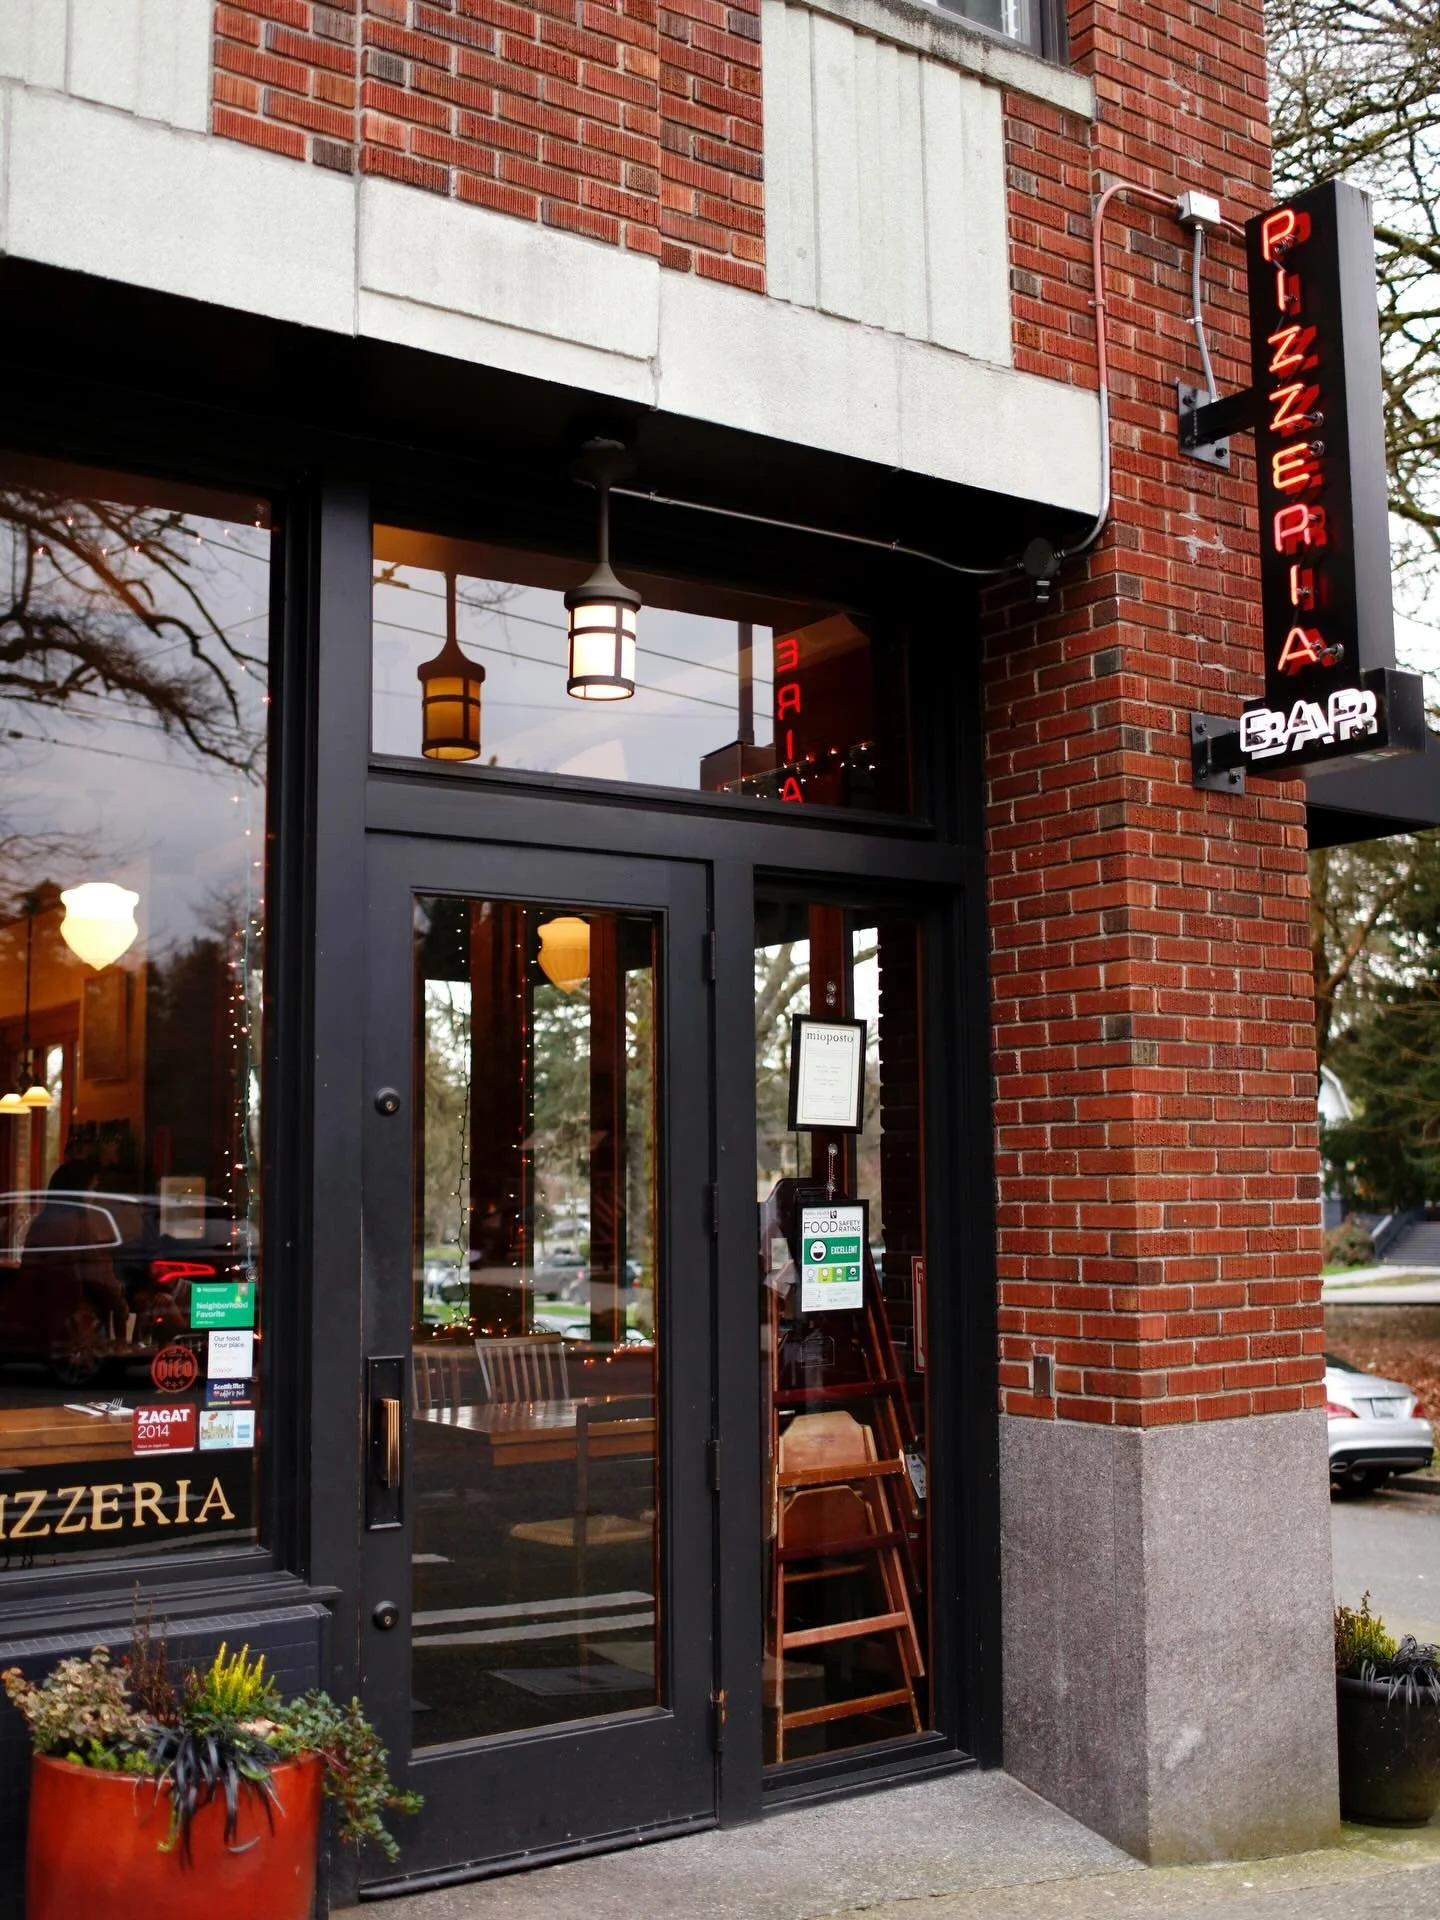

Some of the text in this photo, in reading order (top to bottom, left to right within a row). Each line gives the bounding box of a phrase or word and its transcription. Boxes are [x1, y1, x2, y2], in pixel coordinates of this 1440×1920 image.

[1262, 208, 1325, 675] PIZZERIA
[1239, 688, 1378, 760] BAR
[806, 1030, 854, 1045] mioposto
[803, 1220, 838, 1234] FOOD
[830, 1245, 858, 1255] EXCELLENT
[196, 1310, 225, 1318] Favorite
[137, 1408, 190, 1424] ZAGAT
[137, 1424, 170, 1439] 2014
